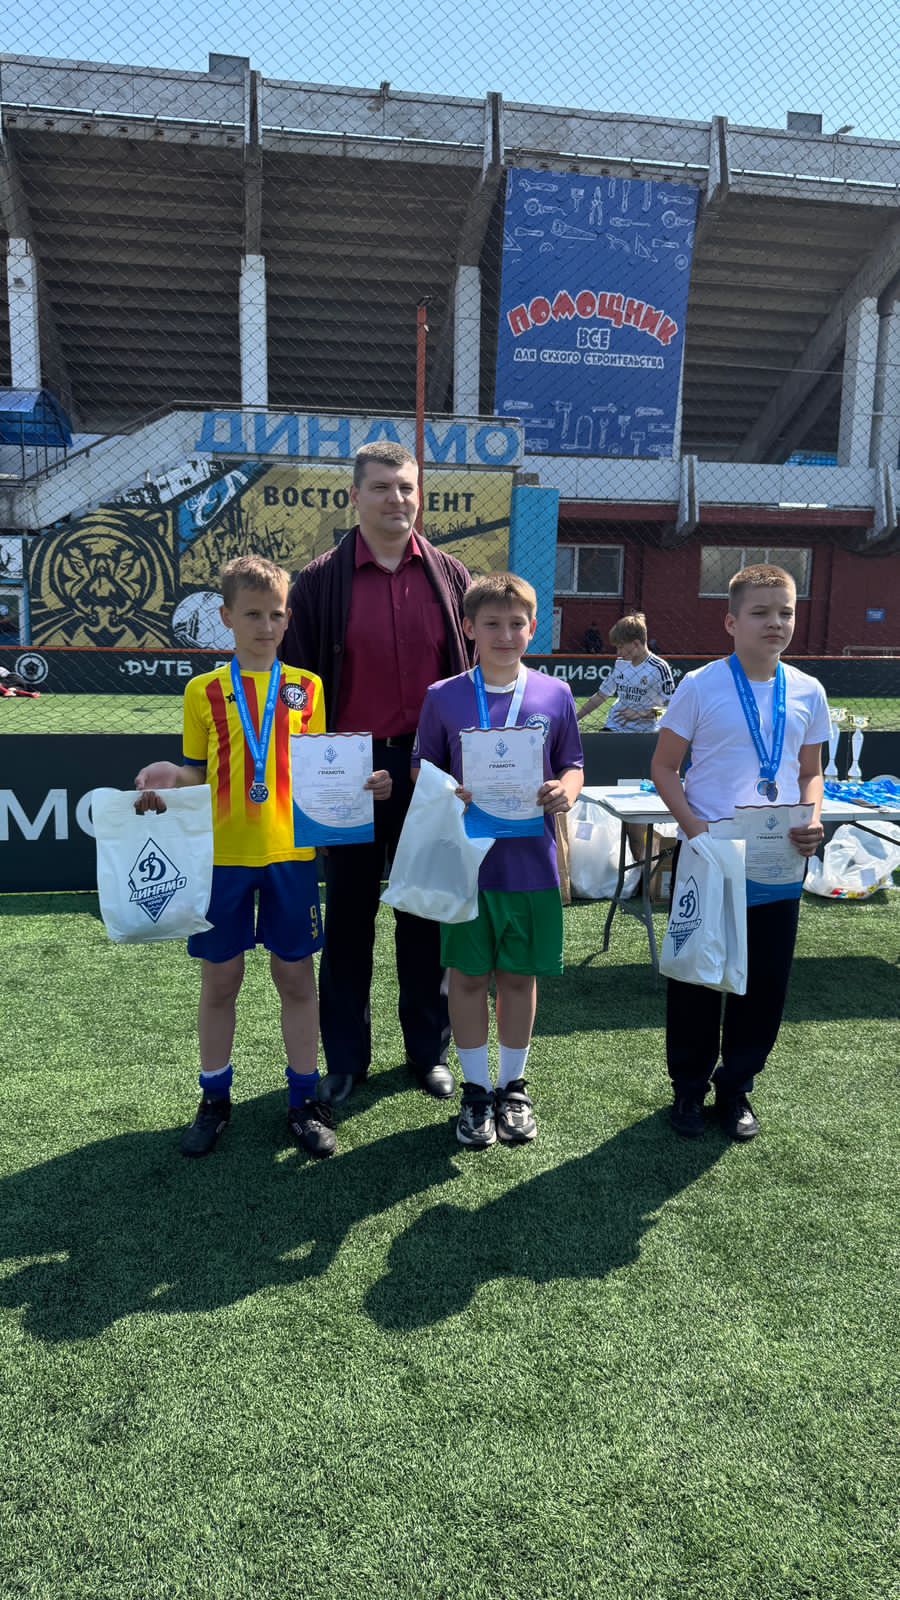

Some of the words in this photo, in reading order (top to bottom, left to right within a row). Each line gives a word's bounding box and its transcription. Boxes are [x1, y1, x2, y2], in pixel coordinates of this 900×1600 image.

[506, 290, 678, 345] ПОМОЩНИК
[576, 327, 610, 349] ВСЕ
[513, 348, 536, 361] ДЛЯ
[584, 353, 664, 368] СТРОИТЕЛЬСТВА
[263, 487, 349, 510] ВОСТО
